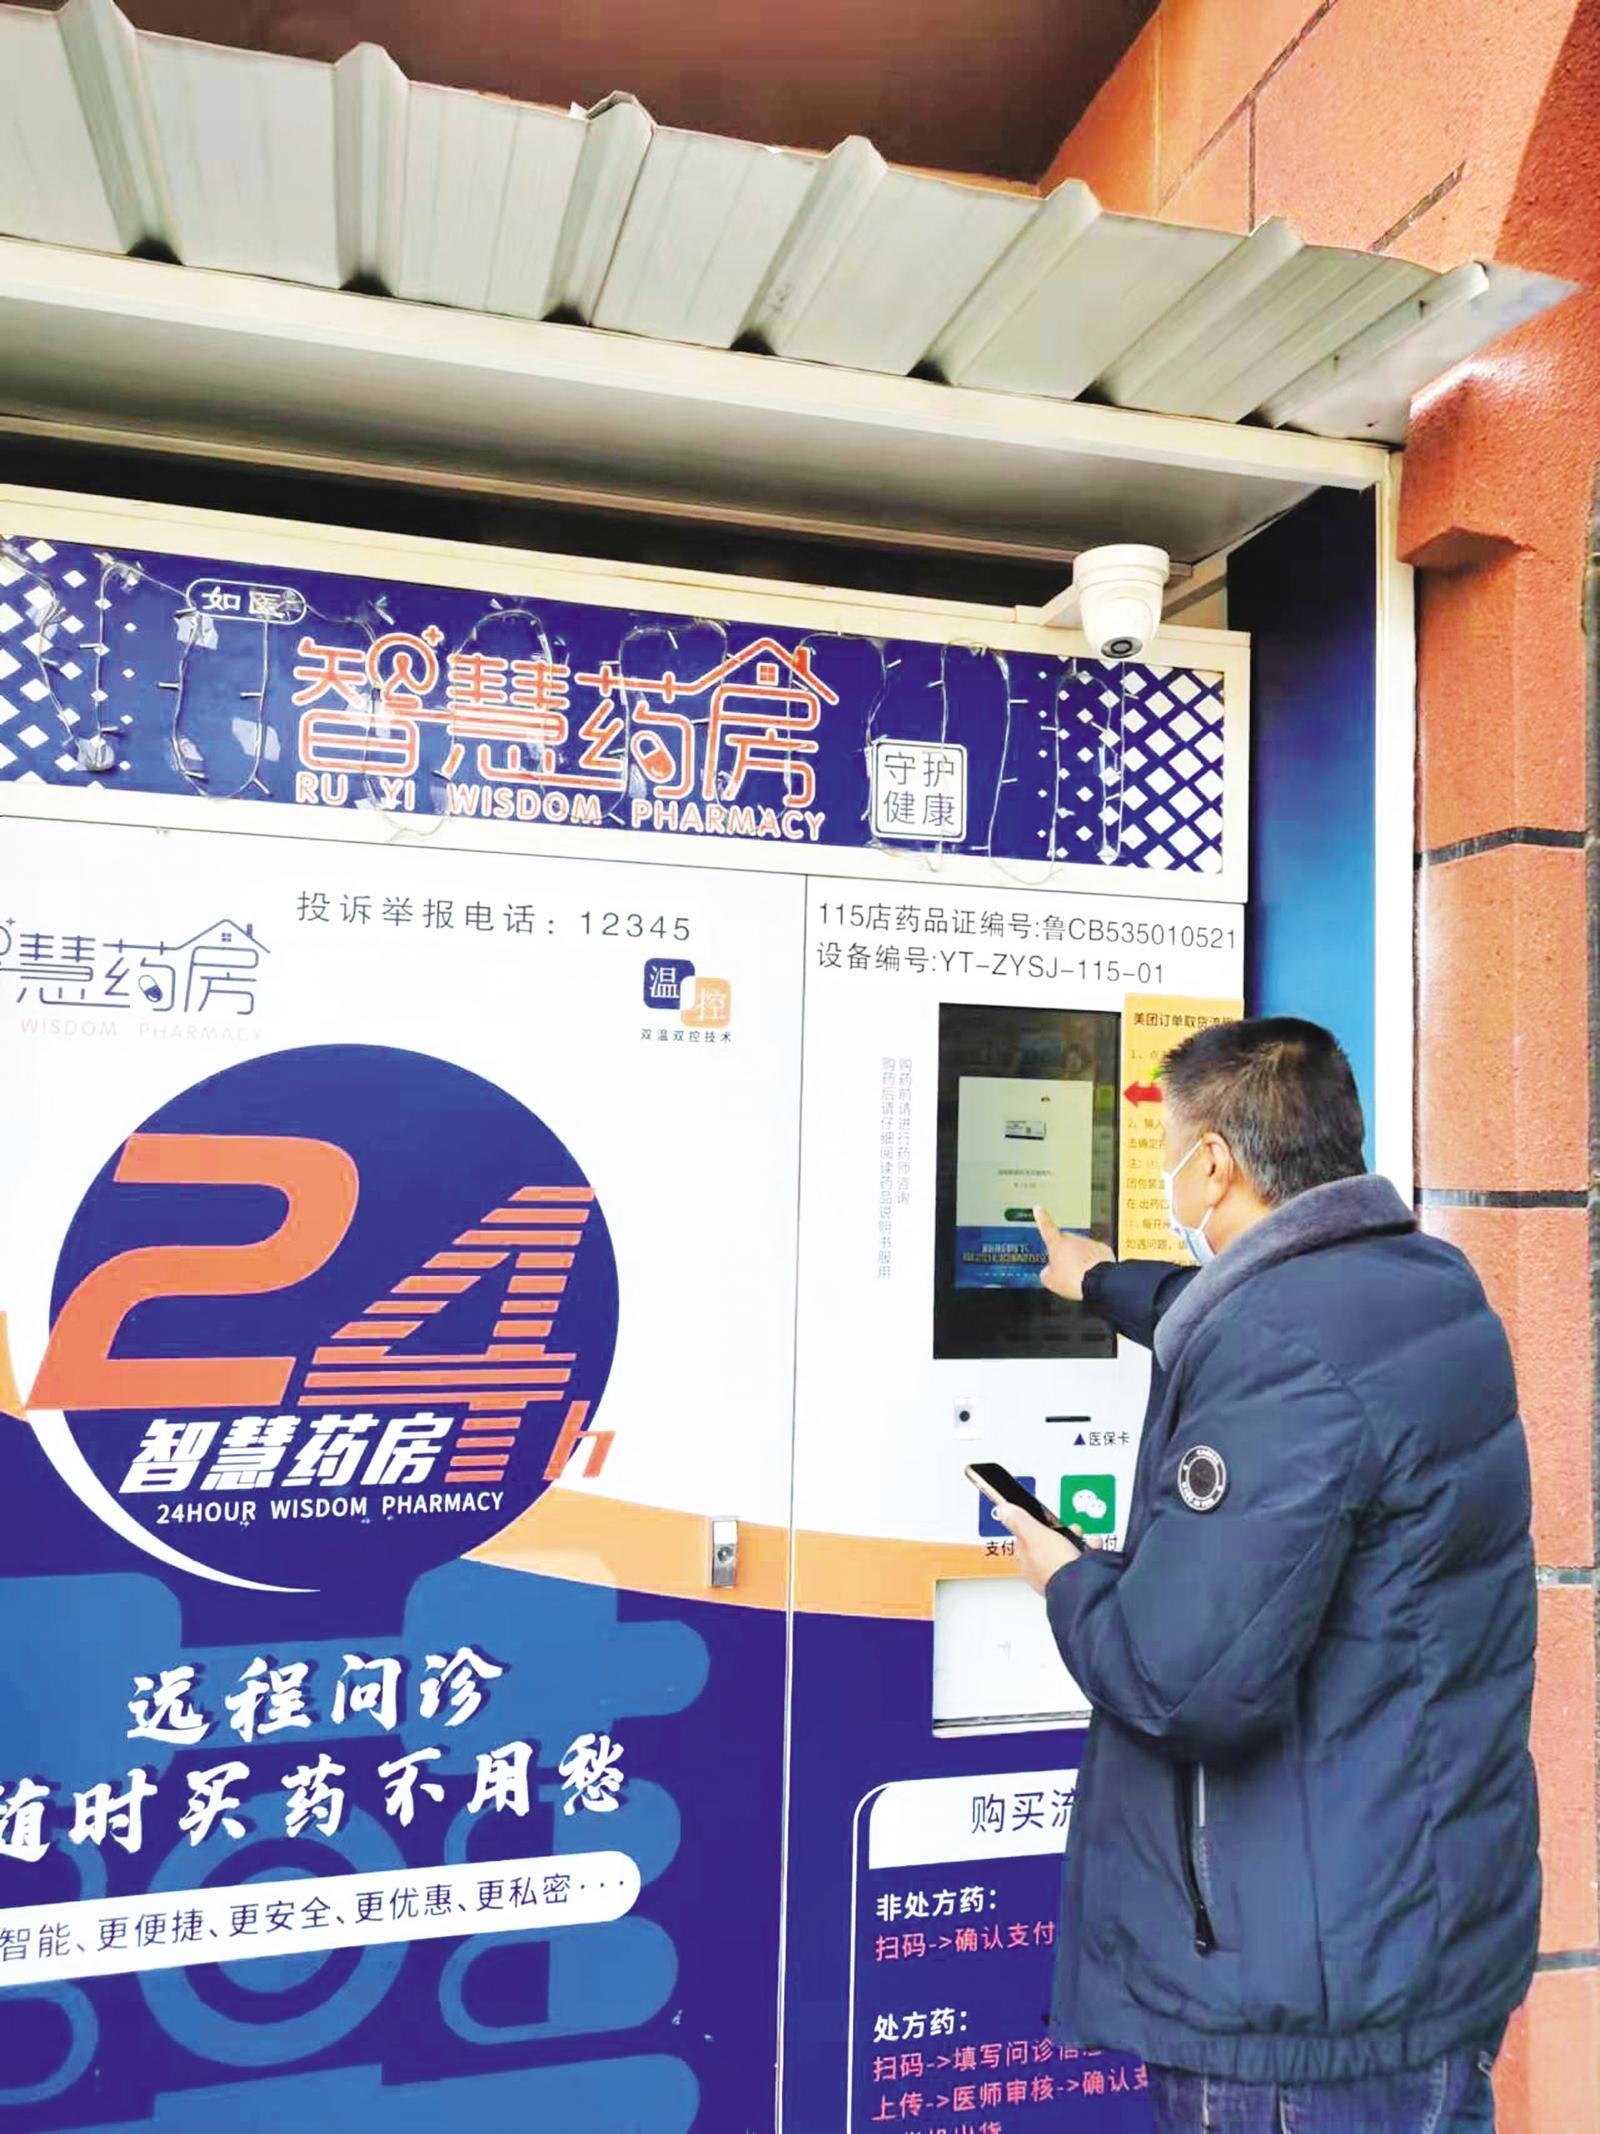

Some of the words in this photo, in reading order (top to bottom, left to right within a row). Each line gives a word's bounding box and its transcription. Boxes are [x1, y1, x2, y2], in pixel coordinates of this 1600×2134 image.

[291, 625, 840, 808] 智慧药房
[883, 752, 956, 788] 守护
[296, 772, 348, 806] RU
[378, 777, 416, 811] YI
[446, 782, 602, 825] WISDOM
[631, 799, 825, 841] PHARMACY
[883, 790, 956, 826] 健康
[580, 910, 691, 942] 12345
[819, 902, 1238, 950] 115店药品证编号:鲁CB535010521
[0, 919, 271, 1015] 慧药房
[649, 964, 681, 999] 温
[816, 941, 1164, 985] 设备编号:YT-ZYSJ-115-01
[20, 1018, 118, 1038] WISDOM
[139, 1023, 263, 1043] PHARMACY
[640, 1028, 732, 1044] 双温双控技术
[118, 1413, 455, 1494] 智慧药房
[1089, 1431, 1130, 1446] 医保卡
[156, 1502, 257, 1525] 24HOUR
[270, 1496, 367, 1519] WISDOM
[381, 1490, 504, 1515] PHARMACY
[126, 1647, 504, 1745] 远程问诊
[0, 1732, 626, 1863] 随时买药不用愁
[875, 1921, 1056, 1962] 扫码->确认支付
